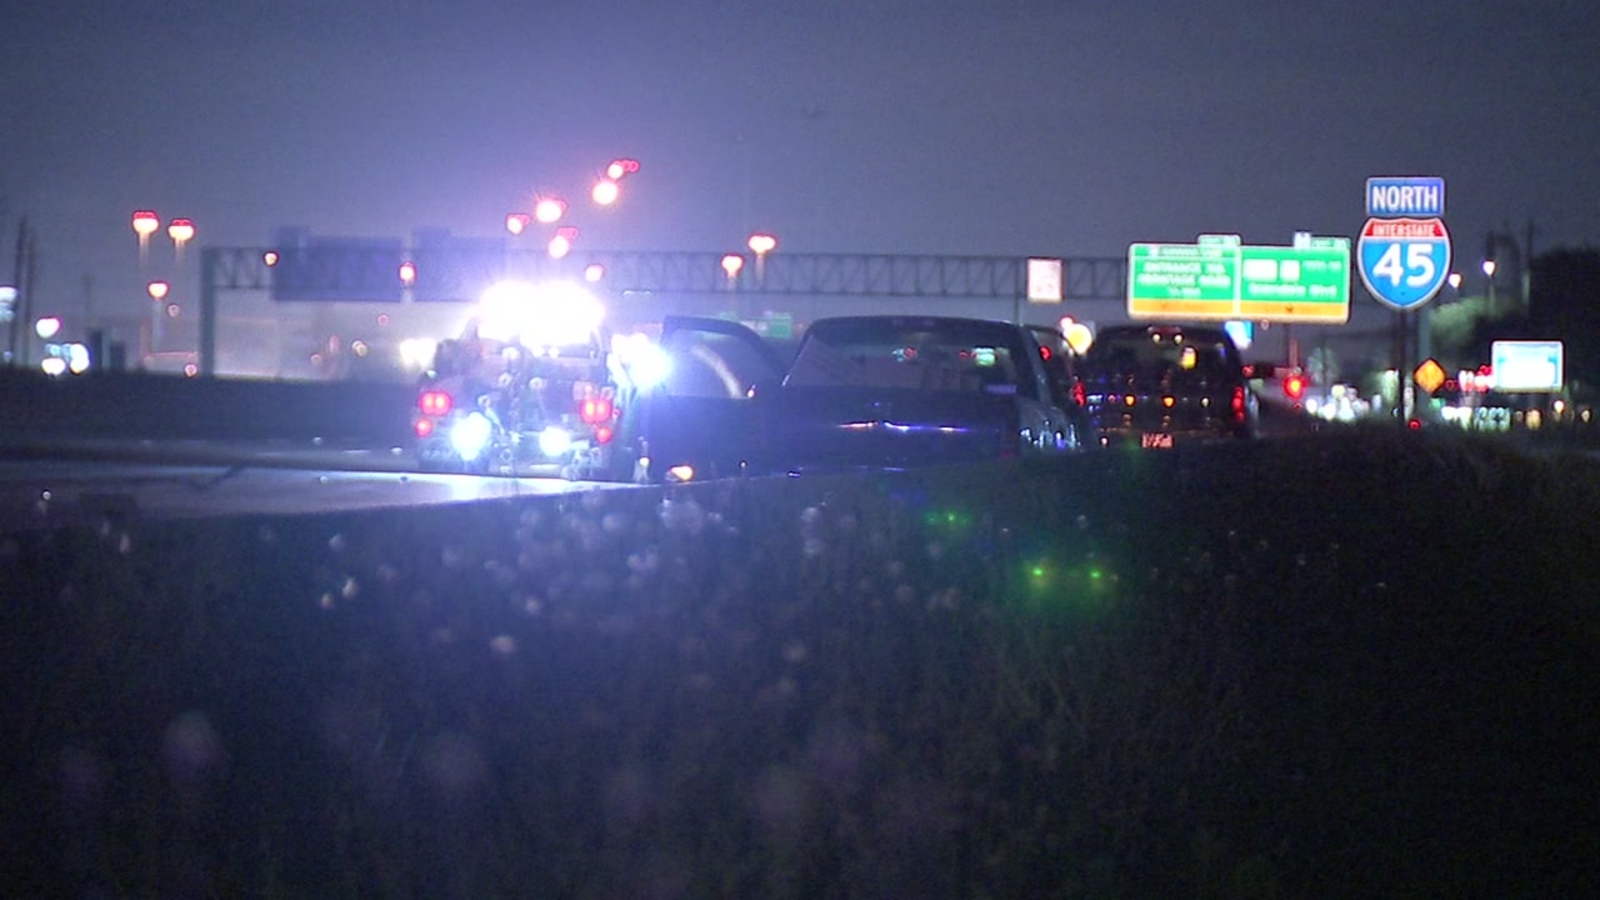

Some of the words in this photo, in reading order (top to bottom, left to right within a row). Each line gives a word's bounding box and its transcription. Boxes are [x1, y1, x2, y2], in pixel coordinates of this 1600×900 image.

[1372, 185, 1438, 212] NORTH
[1373, 224, 1435, 237] INTERSTATE
[1372, 242, 1435, 288] 45
